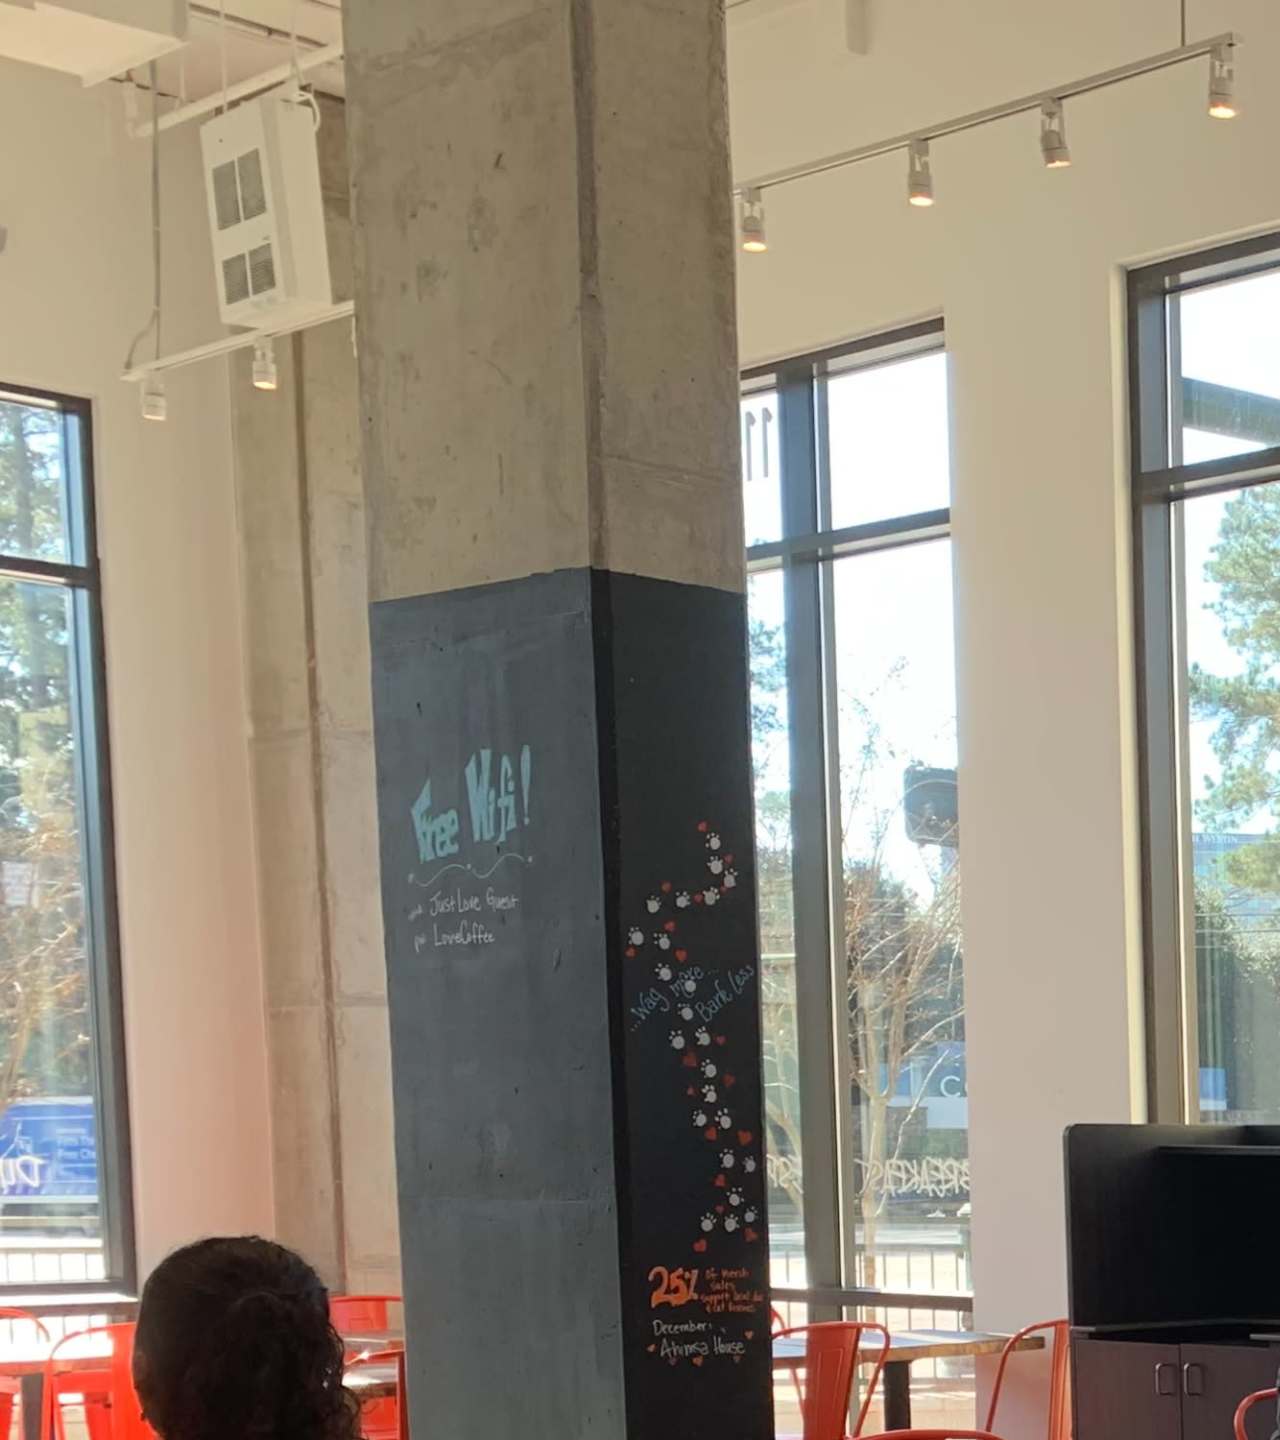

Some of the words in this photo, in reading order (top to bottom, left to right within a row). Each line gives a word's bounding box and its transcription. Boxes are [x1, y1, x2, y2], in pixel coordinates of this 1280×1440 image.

[411, 777, 460, 864] Free
[486, 886, 519, 911] Guest
[648, 1265, 698, 1309] 25%
[713, 1335, 745, 1355] House
